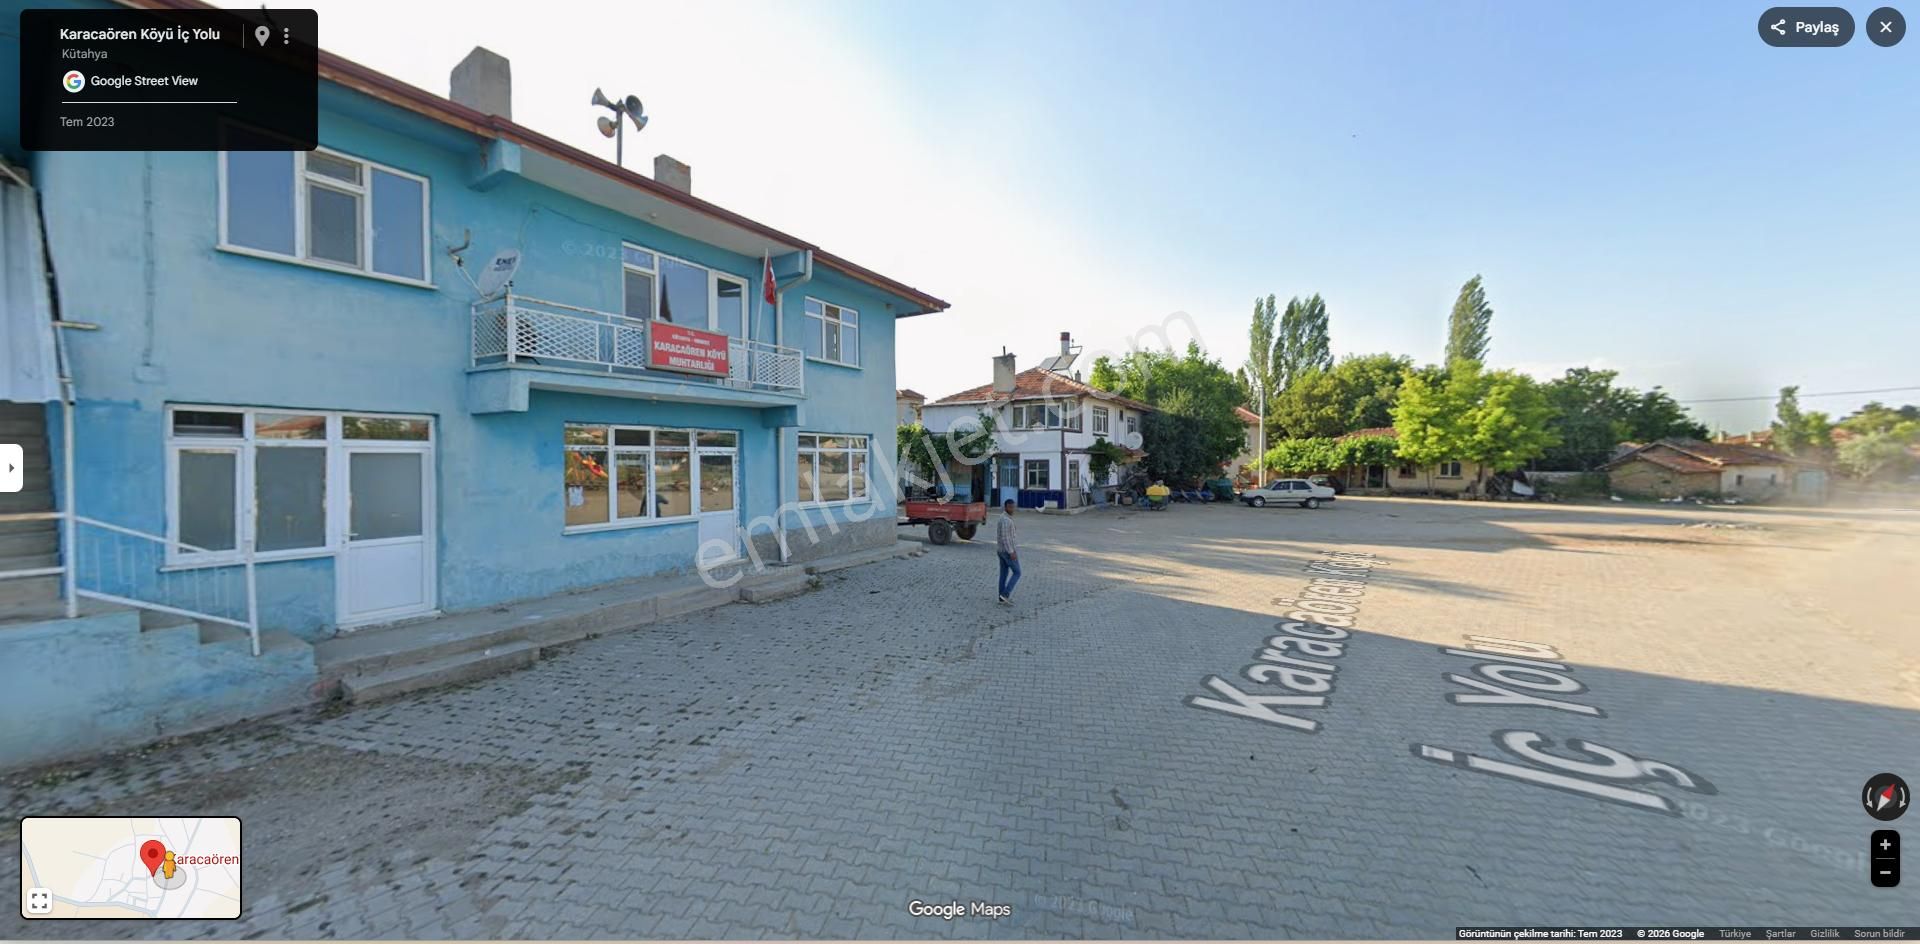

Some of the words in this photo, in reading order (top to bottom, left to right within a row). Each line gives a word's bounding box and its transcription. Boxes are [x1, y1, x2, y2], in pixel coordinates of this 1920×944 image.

[654, 340, 705, 357] KARACAÖREN
[707, 348, 727, 361] KÖYÜ
[668, 356, 715, 371] MUHTARLIĞI
